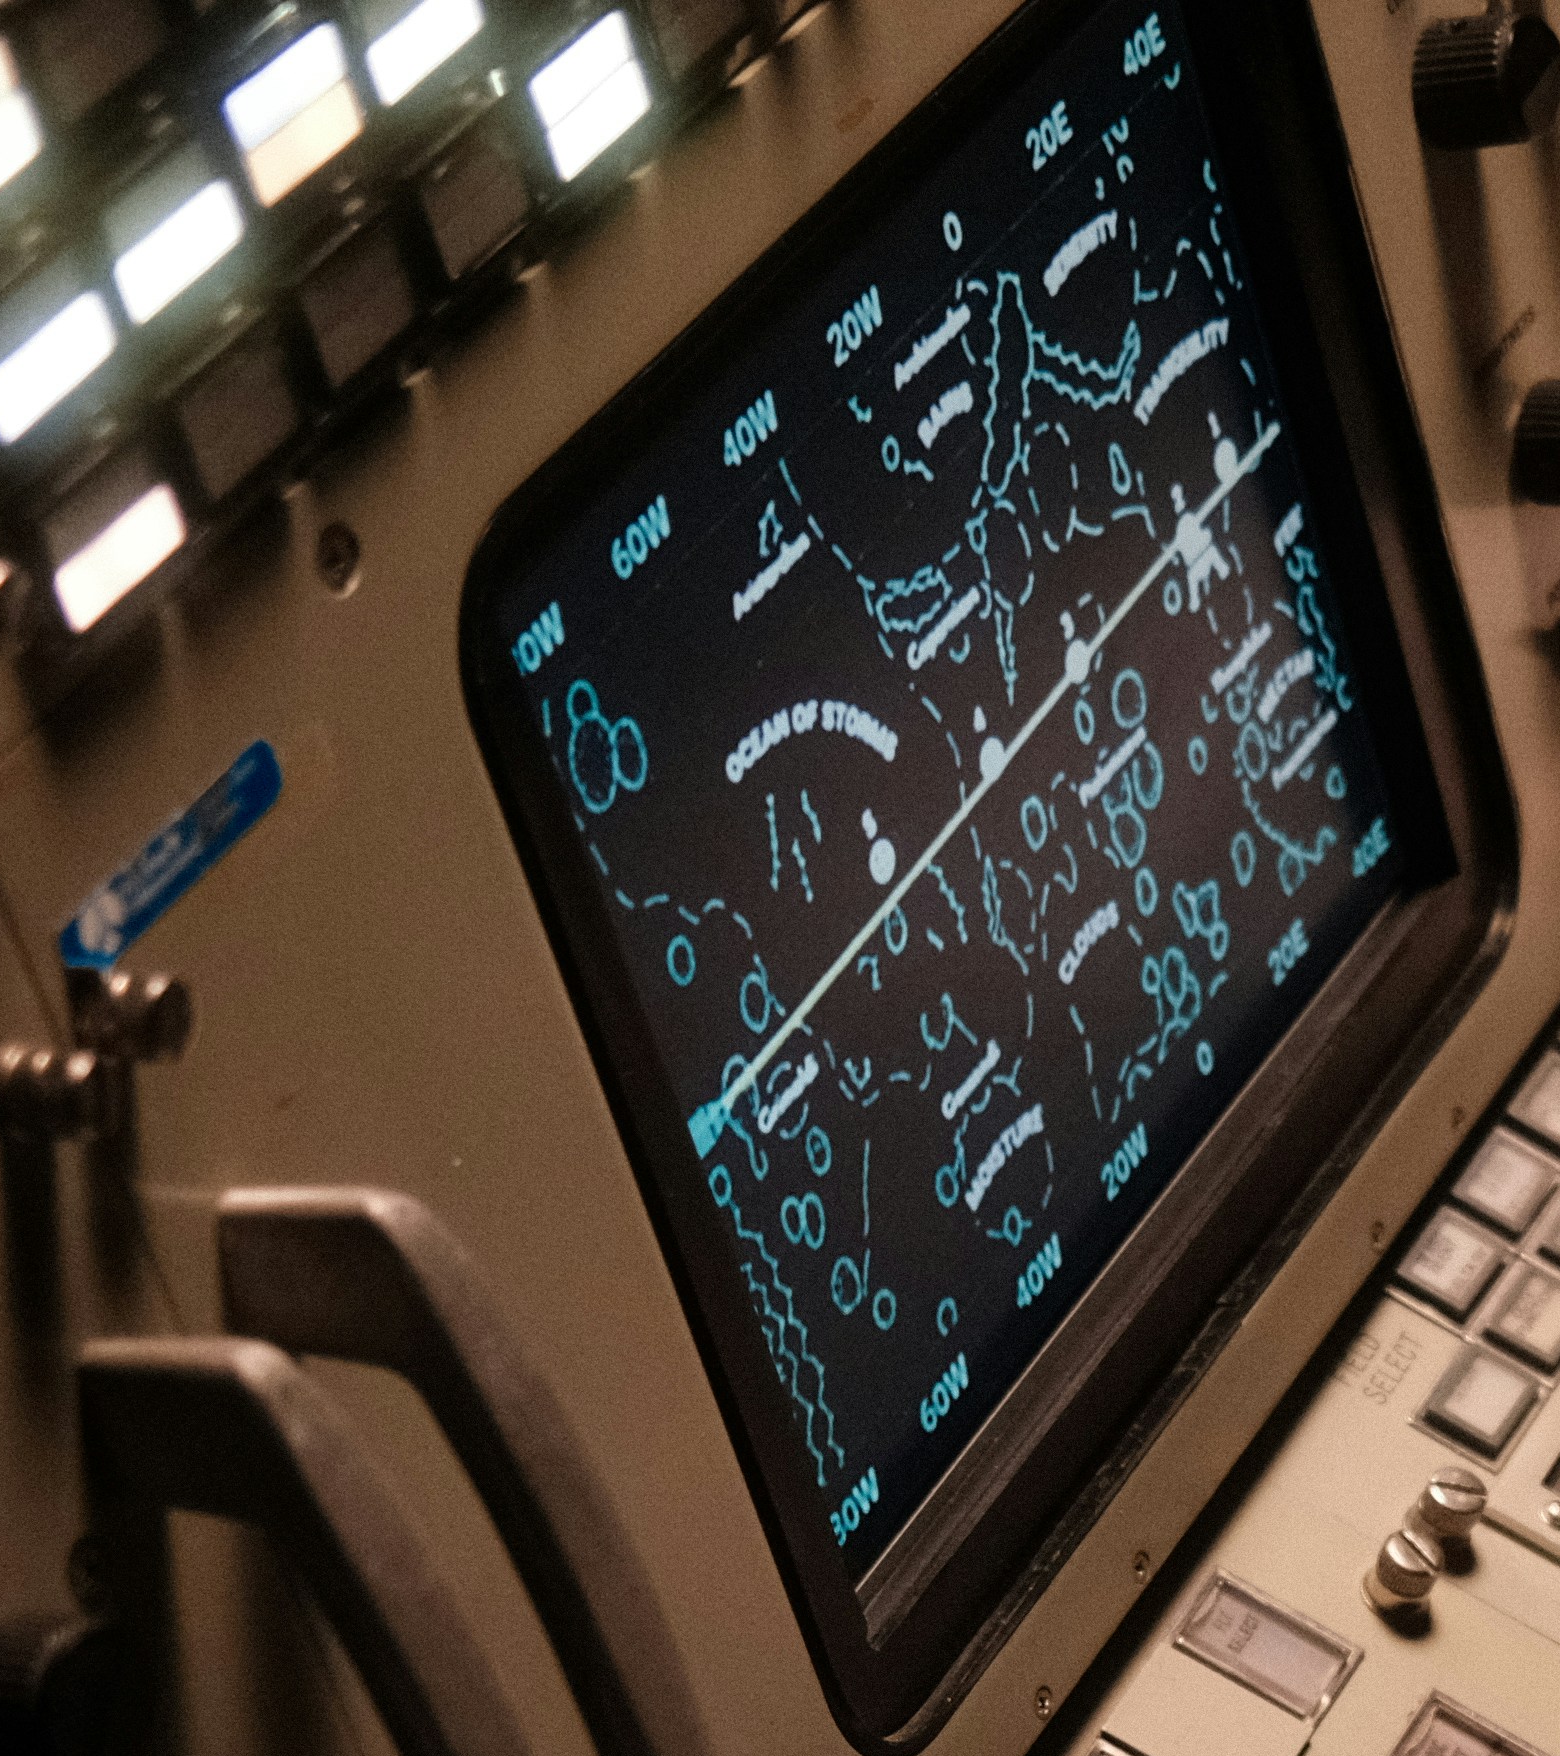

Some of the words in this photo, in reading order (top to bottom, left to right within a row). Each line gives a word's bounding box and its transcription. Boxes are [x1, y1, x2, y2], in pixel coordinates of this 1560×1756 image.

[1124, 12, 1166, 75] 40E
[1026, 101, 1073, 171] 20E
[943, 210, 963, 251] 0
[827, 285, 882, 367] 20W
[724, 390, 777, 466] 40W
[612, 495, 670, 580] 60W
[511, 602, 564, 675] 0W
[725, 704, 791, 783] OCEAN
[793, 699, 819, 733] OF
[822, 700, 897, 762] STORMS
[1352, 817, 1391, 877] 40E
[1269, 921, 1309, 987] 20E
[1100, 1123, 1148, 1201] 20W
[1016, 1234, 1064, 1310] 40W
[920, 1353, 970, 1435] 60W
[1361, 1330, 1424, 1407] SELECT
